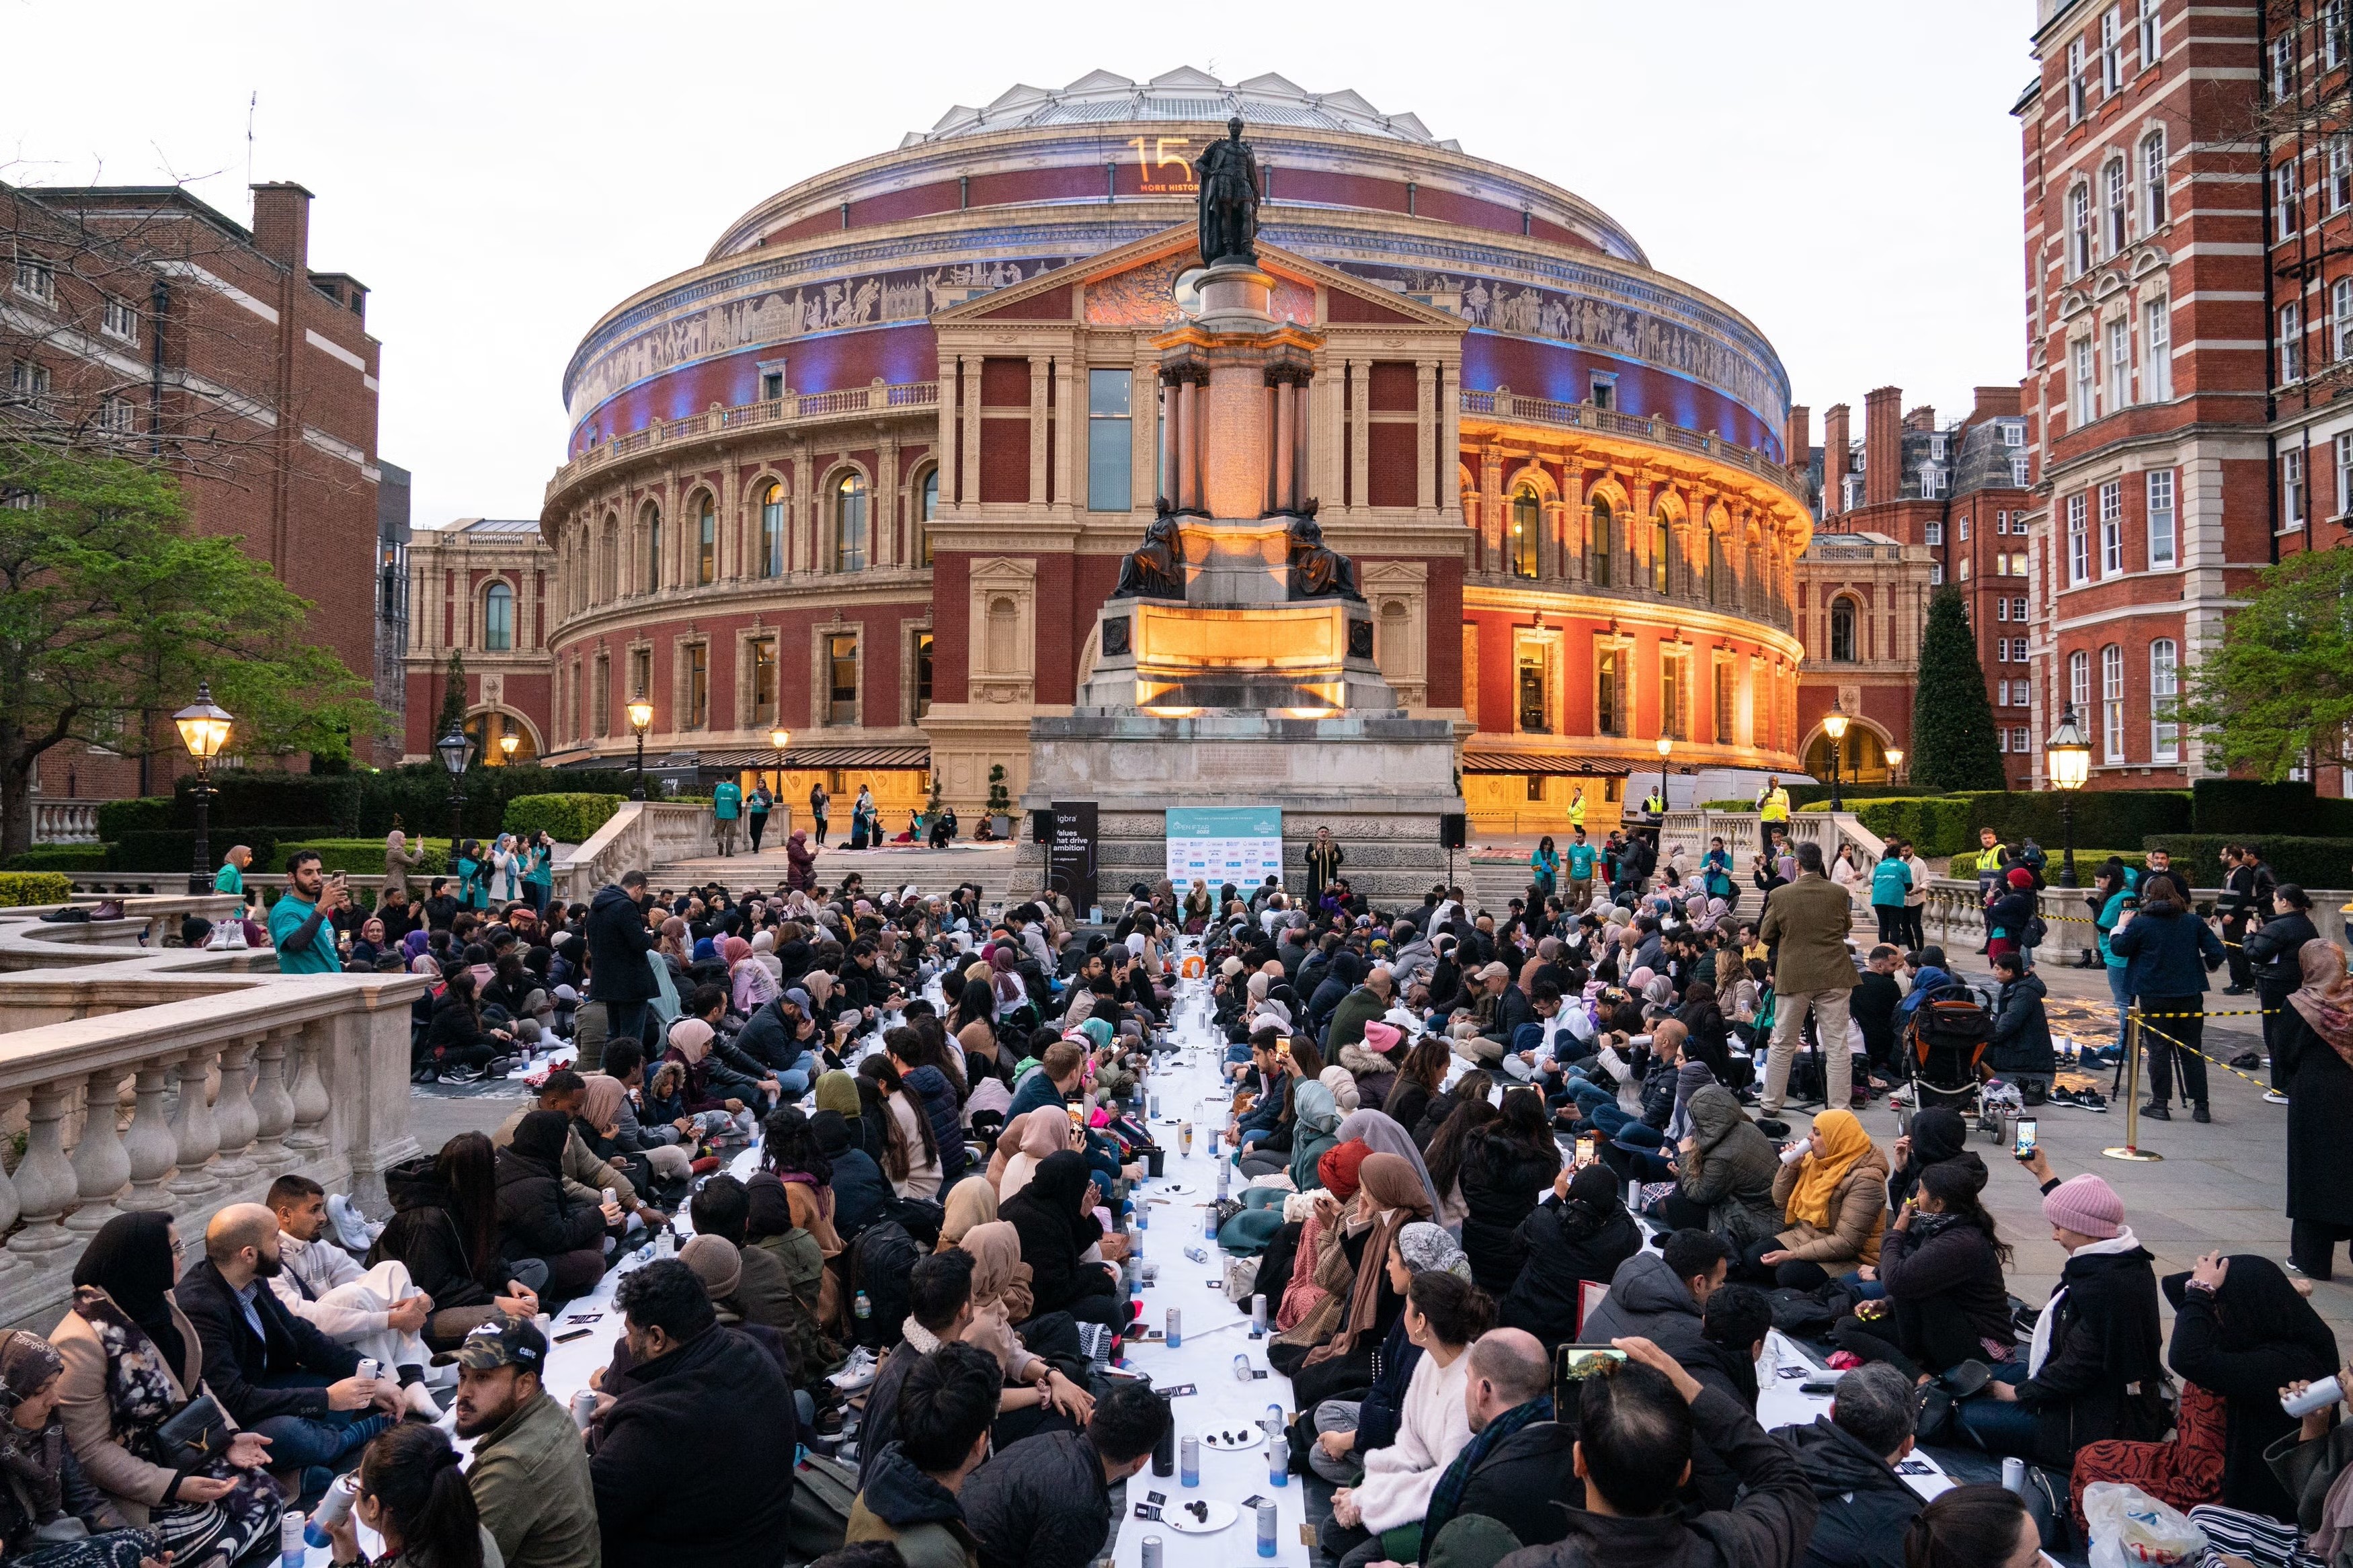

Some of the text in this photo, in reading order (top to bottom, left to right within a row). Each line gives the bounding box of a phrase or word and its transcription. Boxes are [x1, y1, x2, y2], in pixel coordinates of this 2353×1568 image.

[1140, 183, 1199, 192] MORE HISTOR
[887, 256, 931, 266] VICTORIA
[1323, 247, 1333, 255] IT
[1351, 249, 1373, 259] WAS
[1389, 253, 1425, 265] OPENED
[1501, 270, 1535, 282] MAJESTY
[1549, 278, 1564, 288] THE
[1577, 284, 1605, 297] TWENTY
[1057, 815, 1076, 824] lgbra
[519, 1347, 536, 1359] cave
